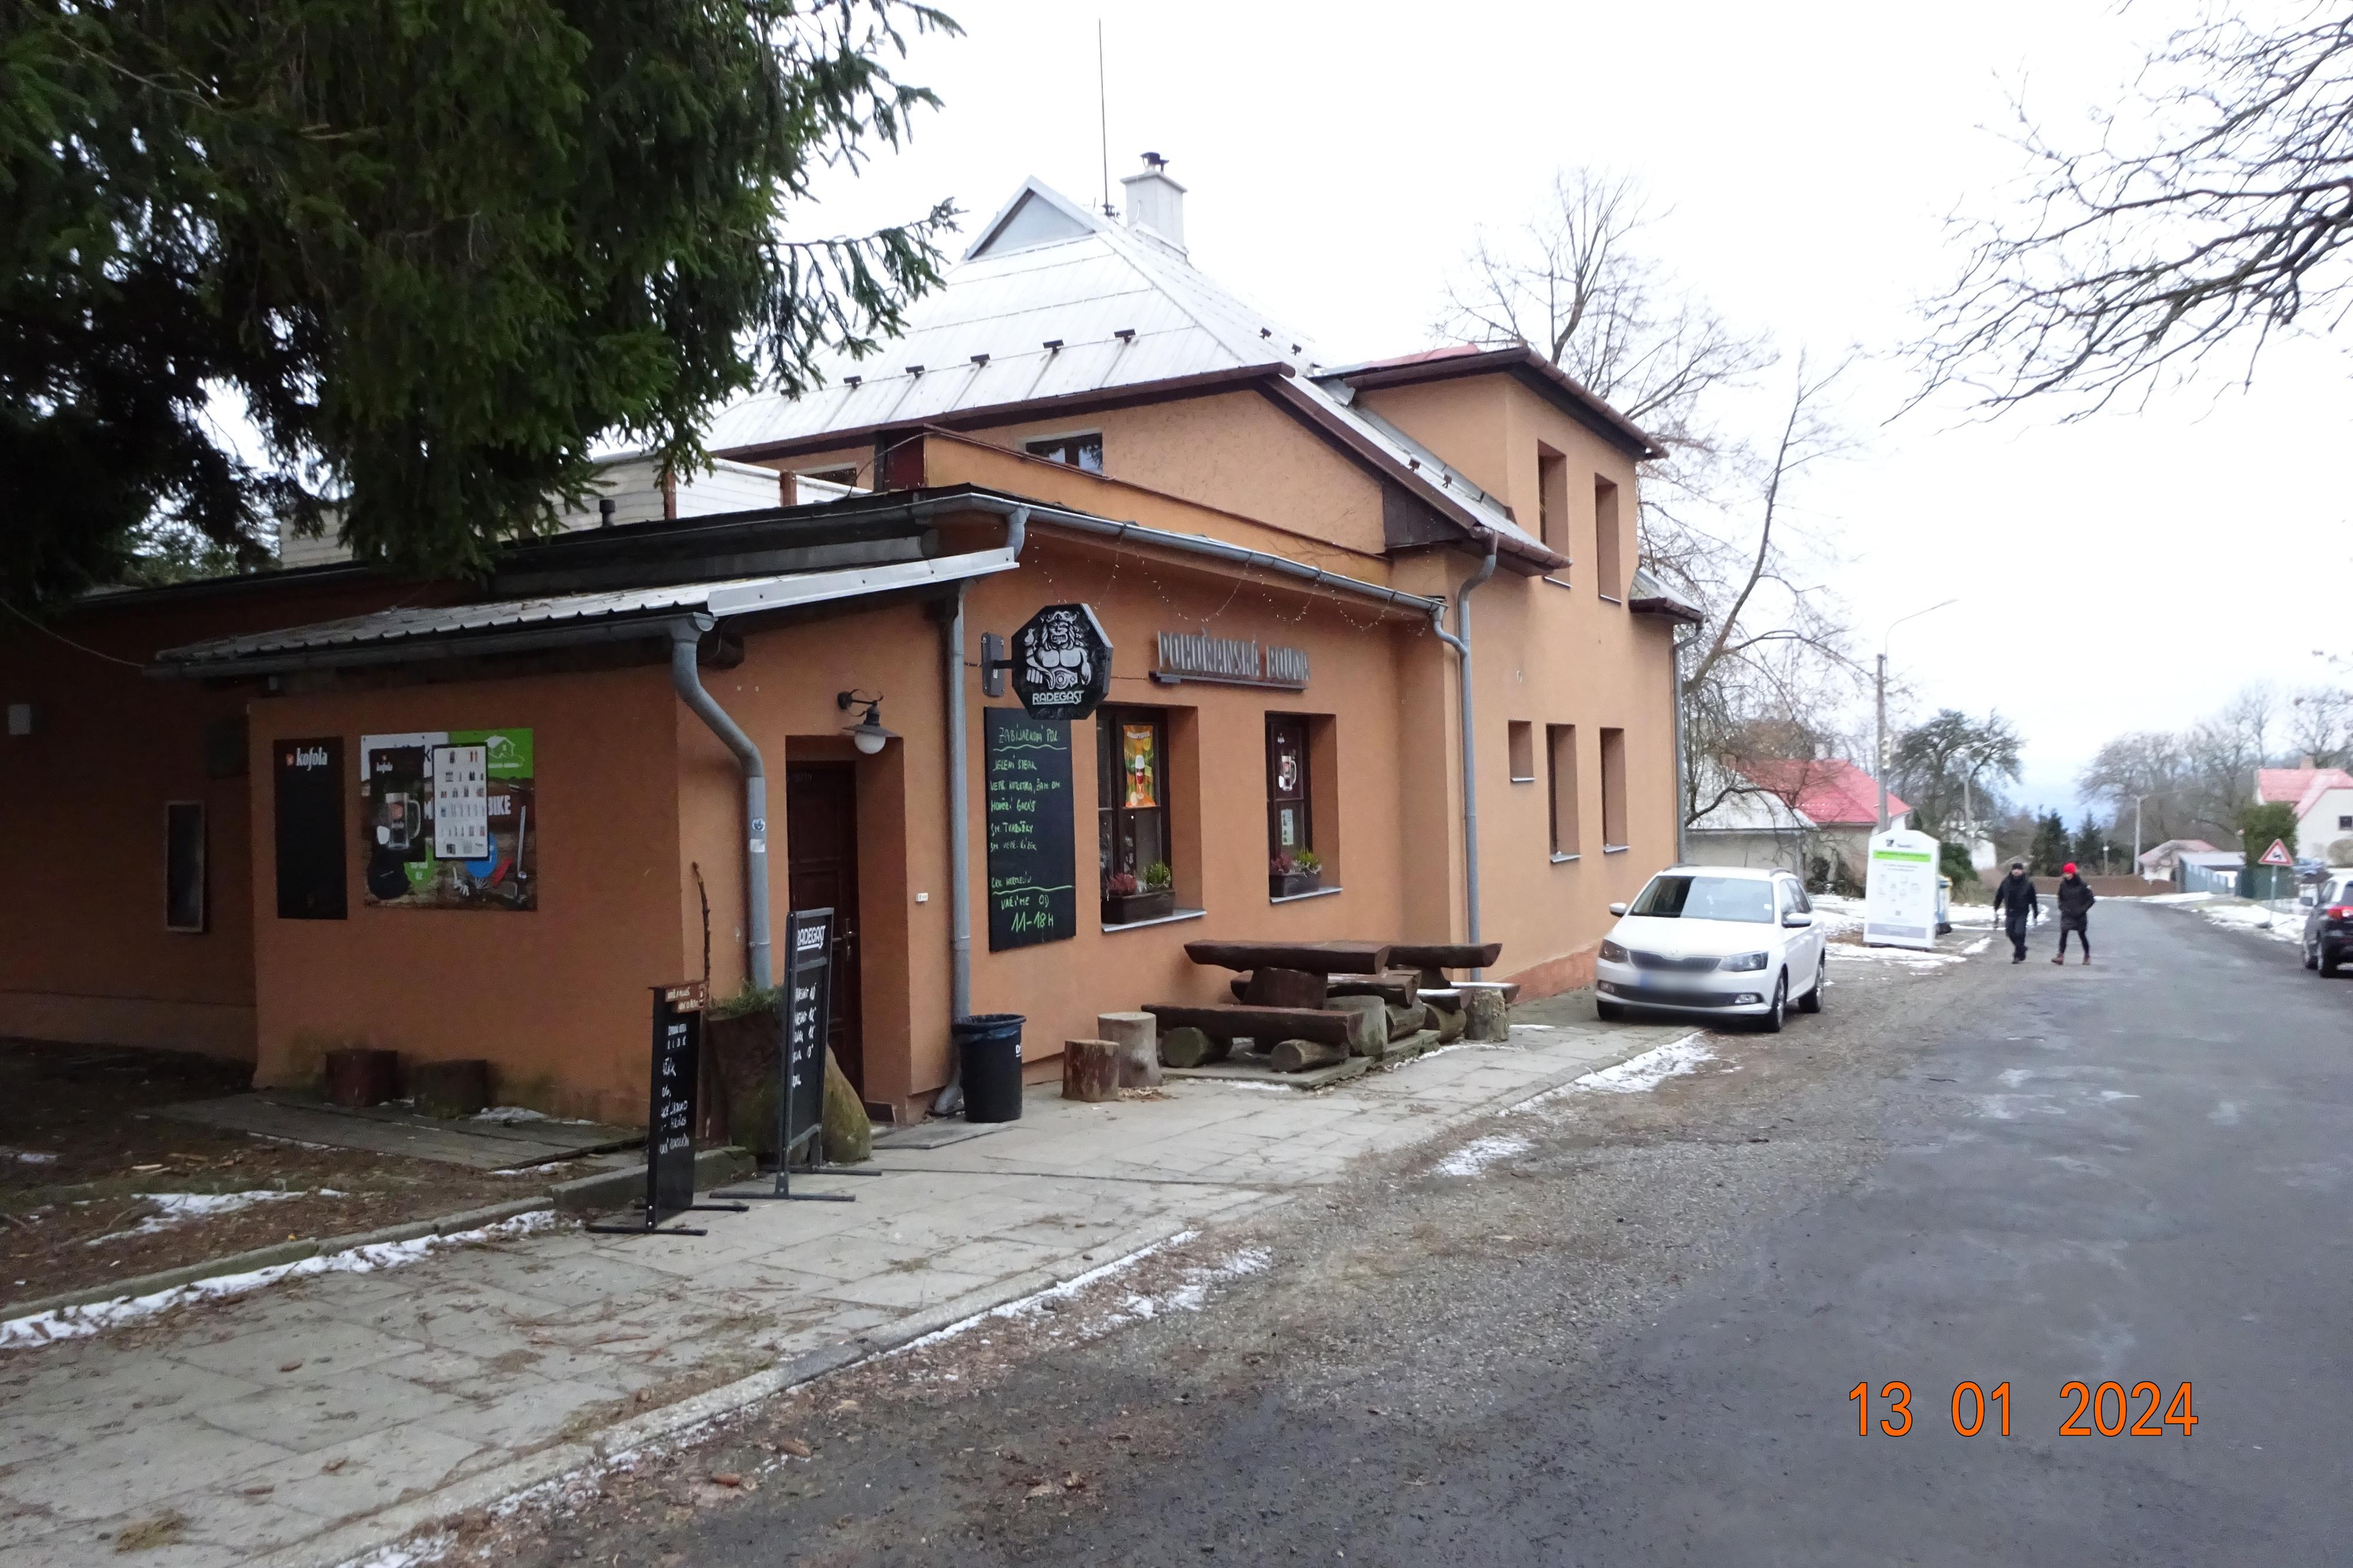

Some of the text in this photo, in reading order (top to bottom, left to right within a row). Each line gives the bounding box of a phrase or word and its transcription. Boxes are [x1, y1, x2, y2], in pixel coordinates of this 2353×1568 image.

[1266, 645, 1309, 682] BOUDA
[1032, 690, 1085, 705] RADEGAST
[296, 747, 328, 772] kofola
[1001, 894, 1049, 910] VAŘÍME OD
